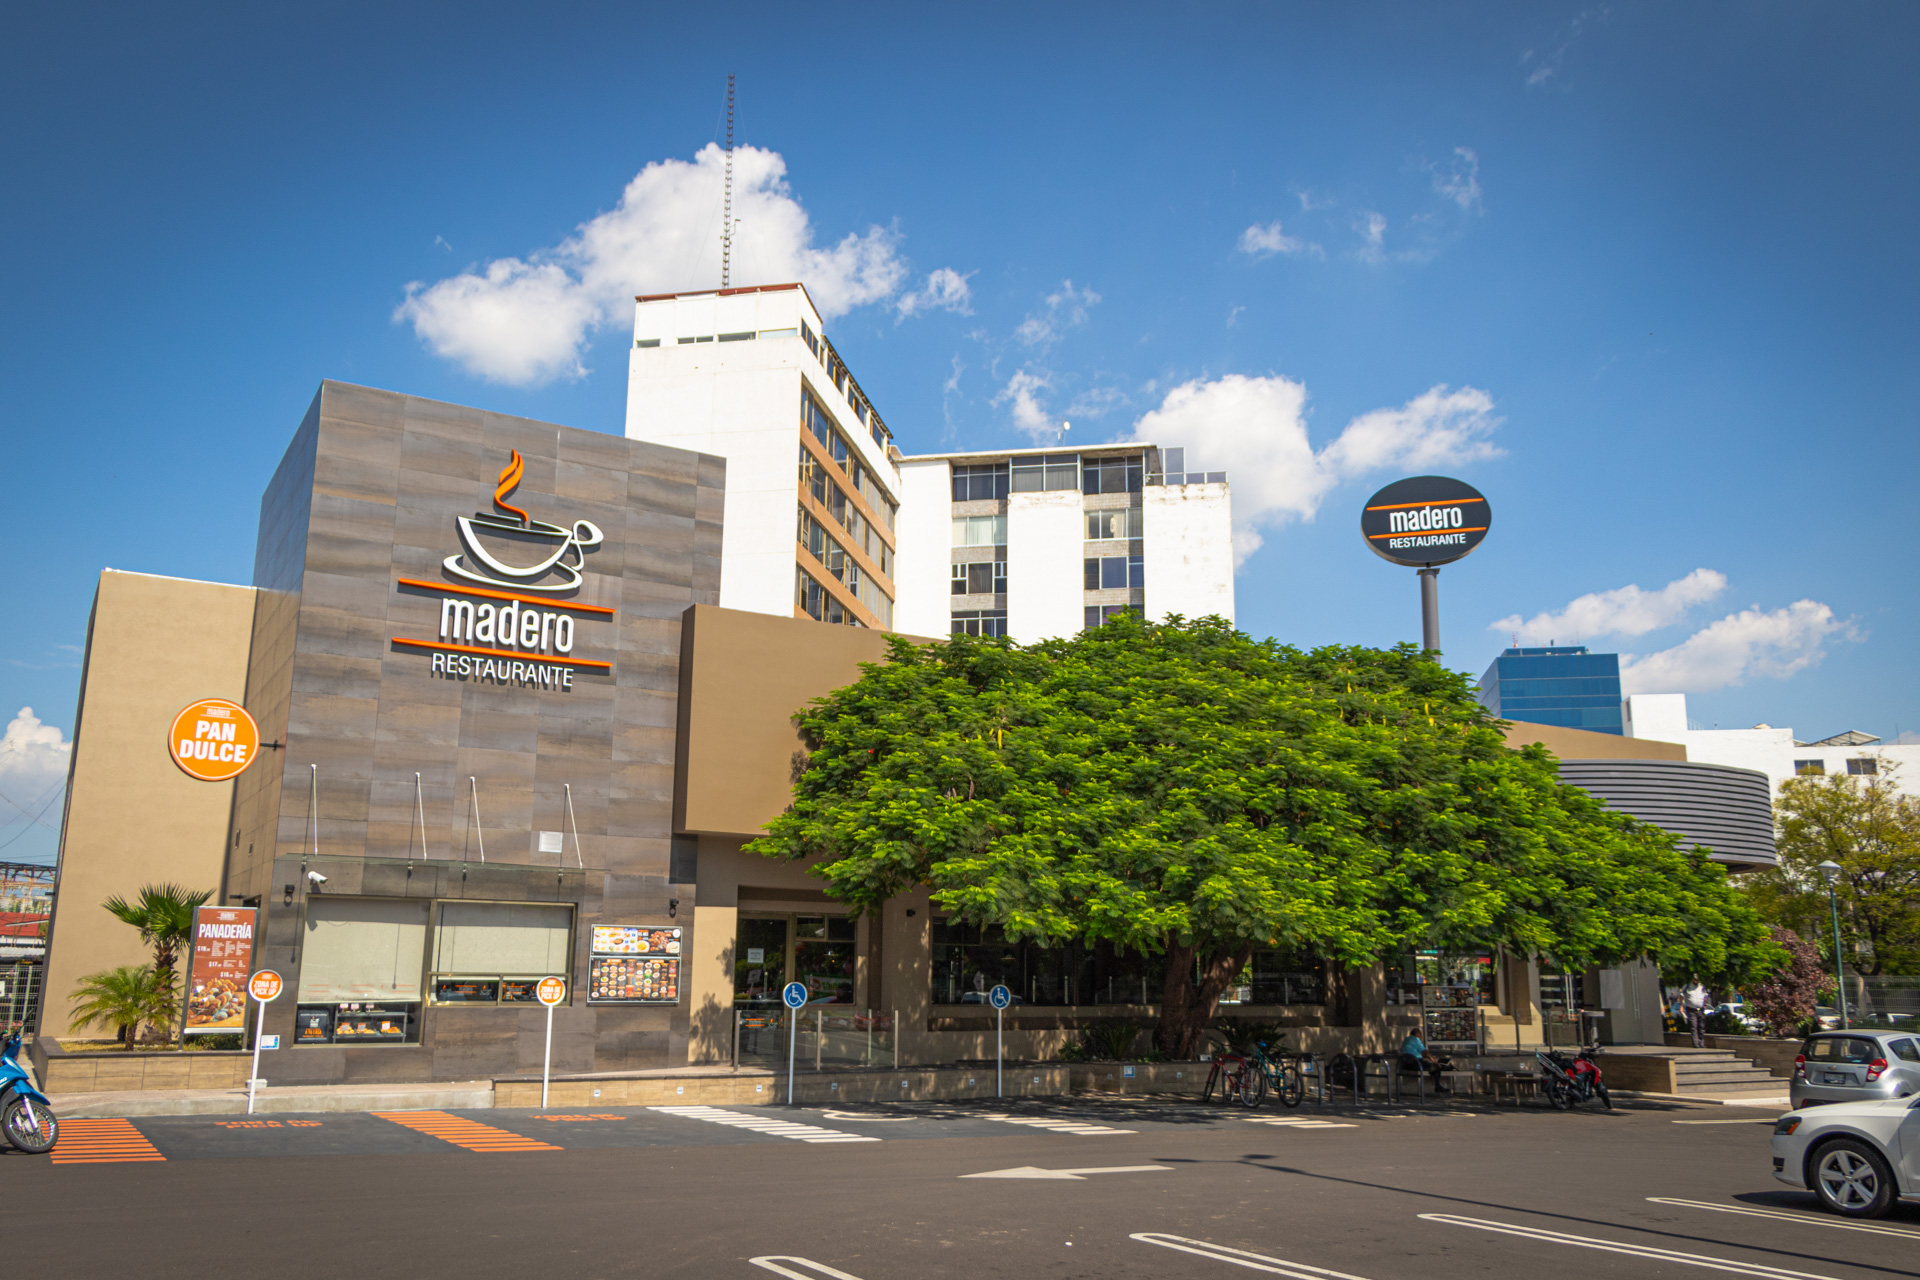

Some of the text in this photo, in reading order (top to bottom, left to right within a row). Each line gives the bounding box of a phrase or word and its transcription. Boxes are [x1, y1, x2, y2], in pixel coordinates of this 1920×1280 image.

[1389, 505, 1463, 533] madero
[1389, 533, 1466, 549] RESTAURANTE
[439, 597, 575, 653] madero
[431, 652, 575, 687] RESTAURANTE
[206, 707, 231, 718] madero
[195, 720, 237, 742] PAN
[179, 739, 247, 763] DULCE
[198, 921, 252, 939] PANADERÍA
[254, 987, 277, 996] PICK UP
